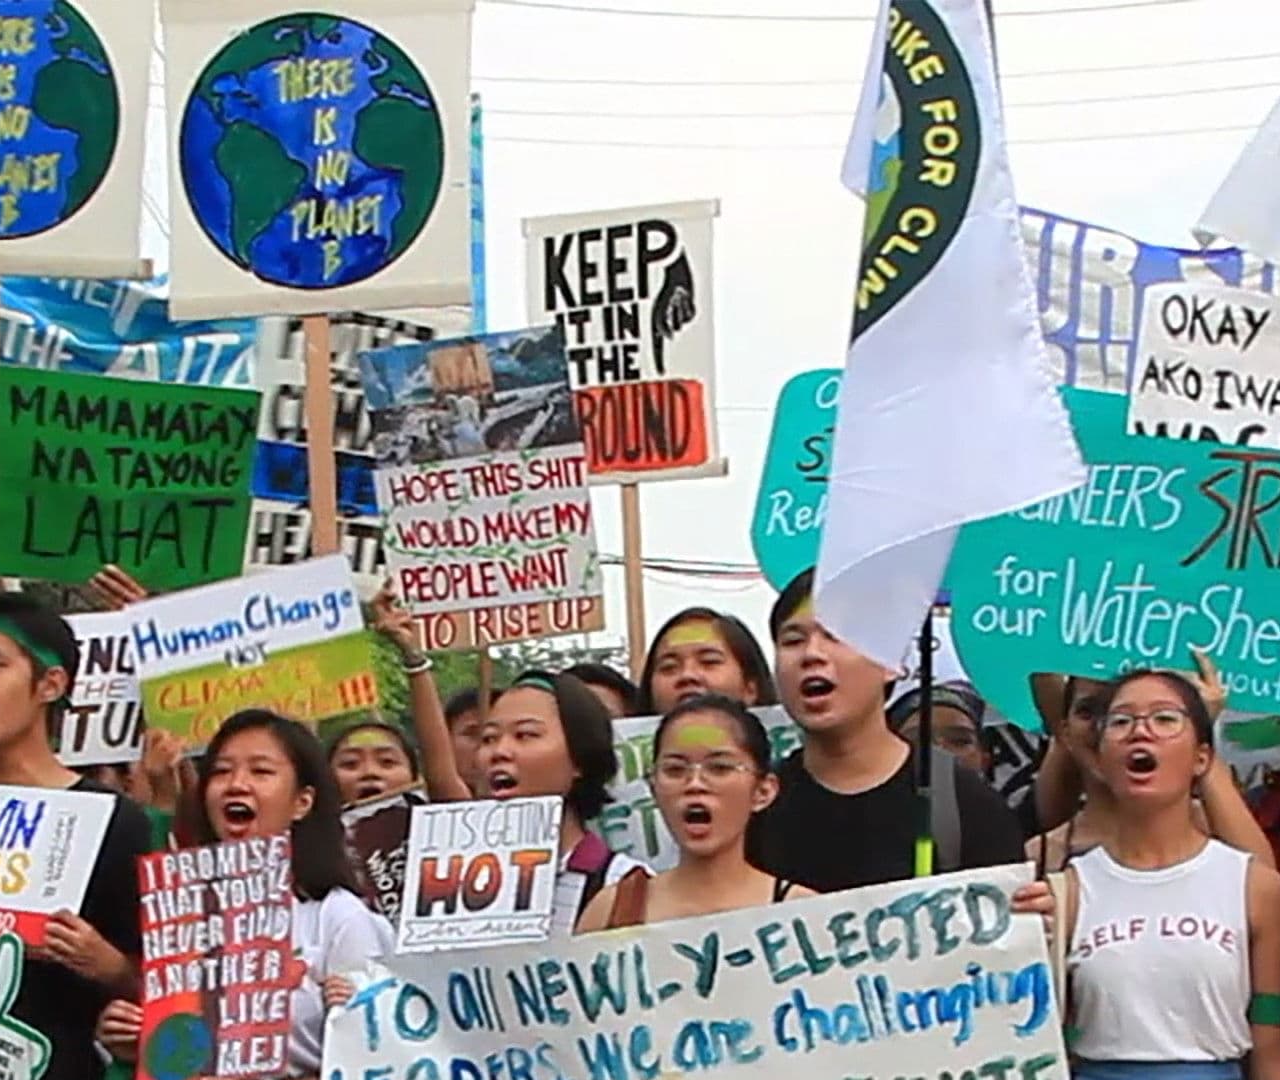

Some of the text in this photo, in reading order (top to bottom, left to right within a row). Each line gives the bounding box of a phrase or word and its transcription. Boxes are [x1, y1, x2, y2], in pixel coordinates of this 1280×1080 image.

[272, 58, 355, 104] THERE
[919, 99, 959, 187] FOR
[291, 195, 383, 243] PLANET
[544, 219, 677, 311] KEEP
[557, 304, 640, 343] IT IN
[1161, 294, 1271, 352] OKAY
[569, 345, 640, 384] THE
[1140, 357, 1202, 402] AKO
[31, 441, 242, 490] NA TAYONG
[391, 457, 587, 504] HOPE THIS SHIT
[23, 496, 236, 574] LAHAT
[396, 514, 478, 549] WOULD
[484, 507, 553, 545] MAKE
[553, 502, 591, 536] MY
[401, 548, 569, 602] PEOPLE WANT
[993, 556, 1057, 599] for
[131, 588, 354, 663] Human Change
[415, 613, 455, 650] TO
[472, 607, 543, 646] RISE
[972, 604, 1046, 638] our
[225, 641, 269, 668] NOT
[144, 836, 289, 888] I PROMISE
[415, 850, 552, 917] HOT
[141, 884, 208, 922] THAT
[143, 906, 290, 960] NEVER FIND
[1081, 918, 1236, 959] SELF LOVE
[145, 950, 281, 1001] ANOTHER
[220, 989, 289, 1027] LIKE
[349, 977, 438, 1051] TO
